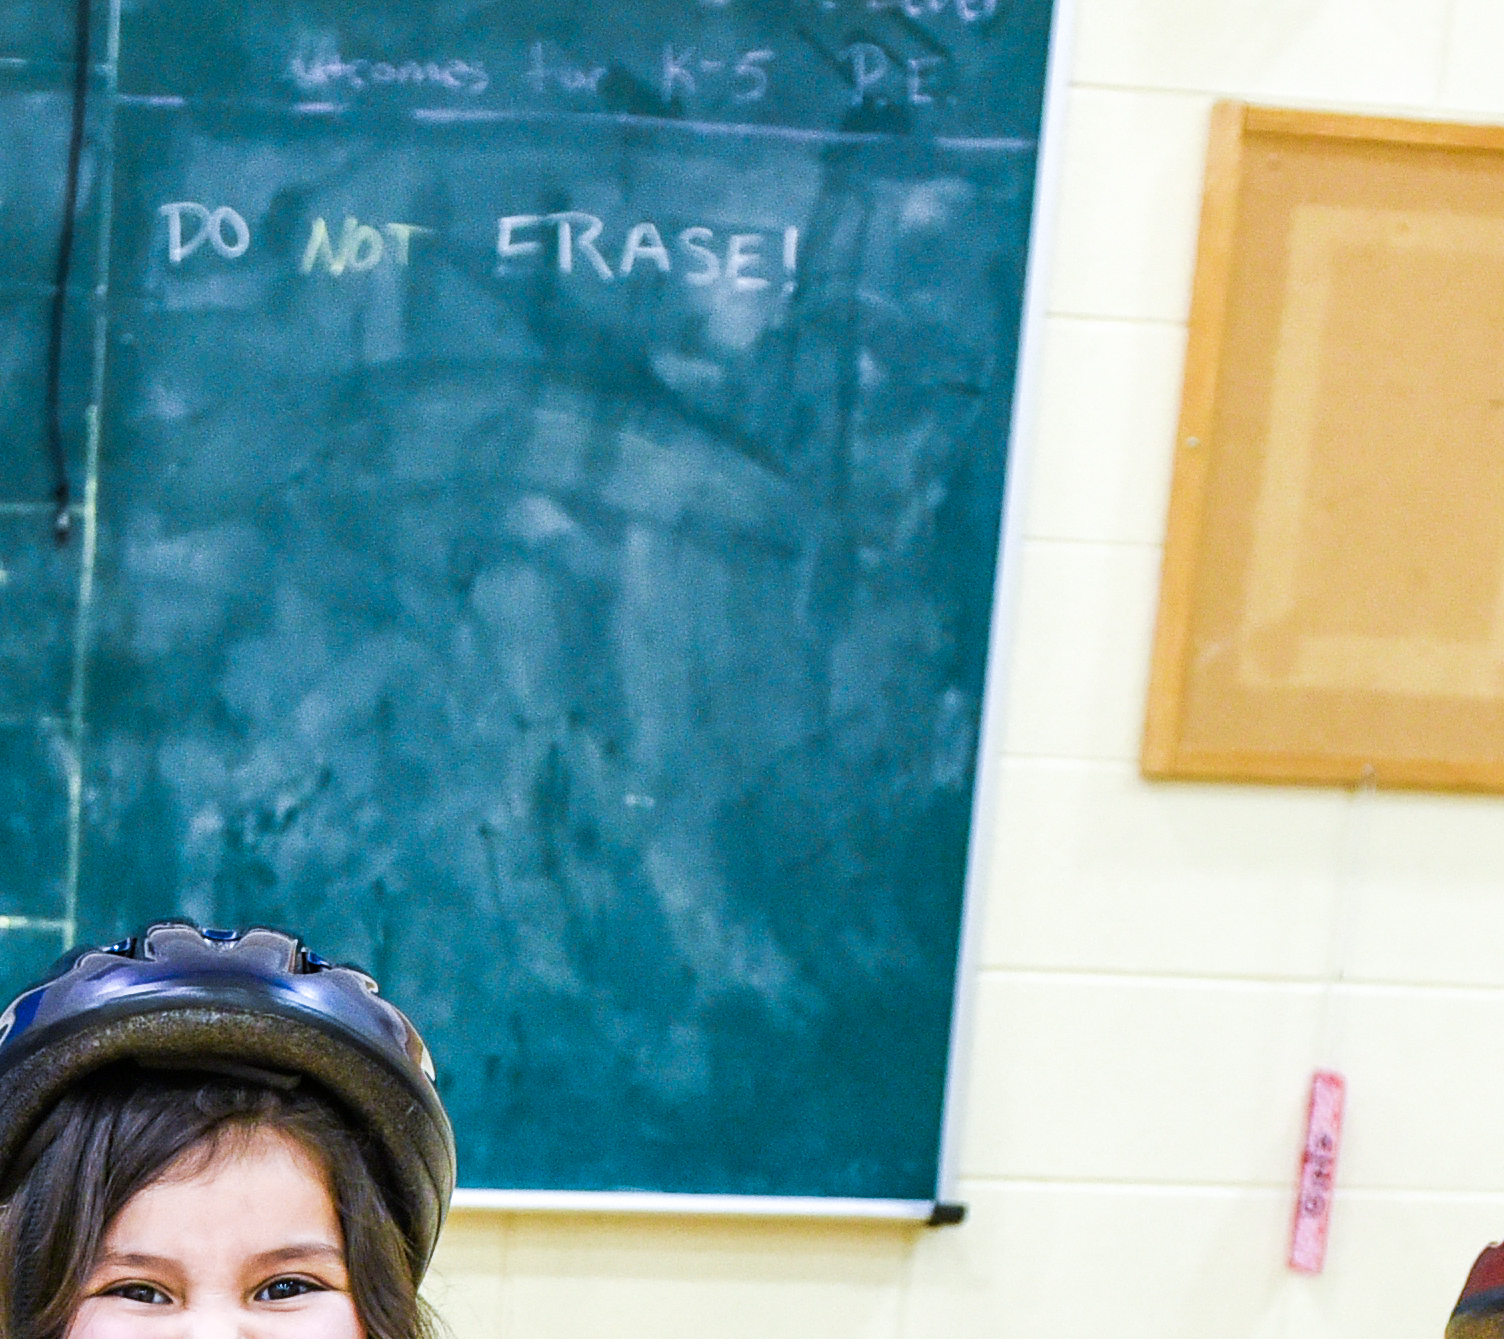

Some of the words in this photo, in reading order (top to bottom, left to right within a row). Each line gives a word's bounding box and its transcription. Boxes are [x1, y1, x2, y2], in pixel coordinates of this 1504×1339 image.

[158, 202, 251, 264] DO
[300, 216, 438, 278] NOT
[495, 211, 800, 300] ERASE!
